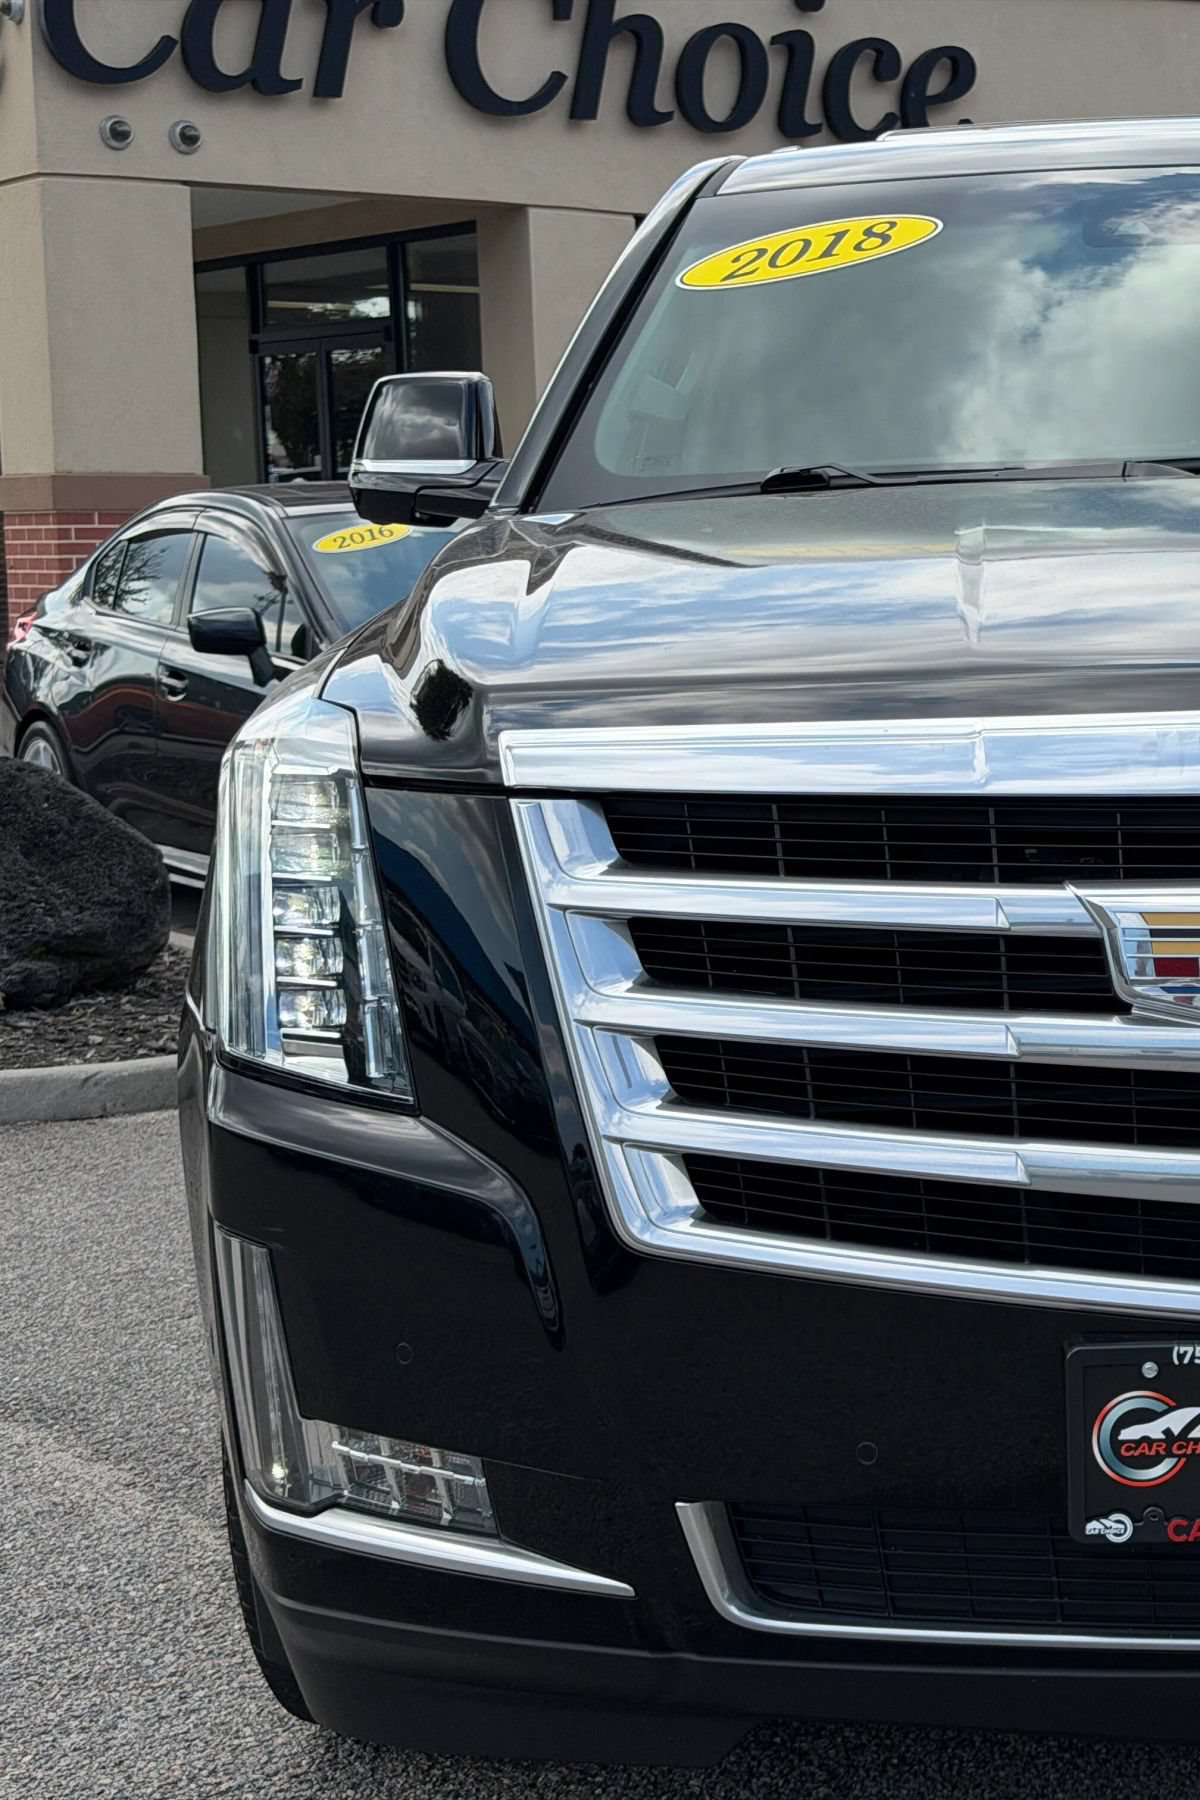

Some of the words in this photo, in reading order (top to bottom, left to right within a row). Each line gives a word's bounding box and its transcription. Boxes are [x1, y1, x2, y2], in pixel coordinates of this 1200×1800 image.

[445, 0, 977, 142] Choice
[719, 220, 899, 283] 2018
[333, 526, 394, 549] 2016
[1120, 1441, 1166, 1457] CAR
